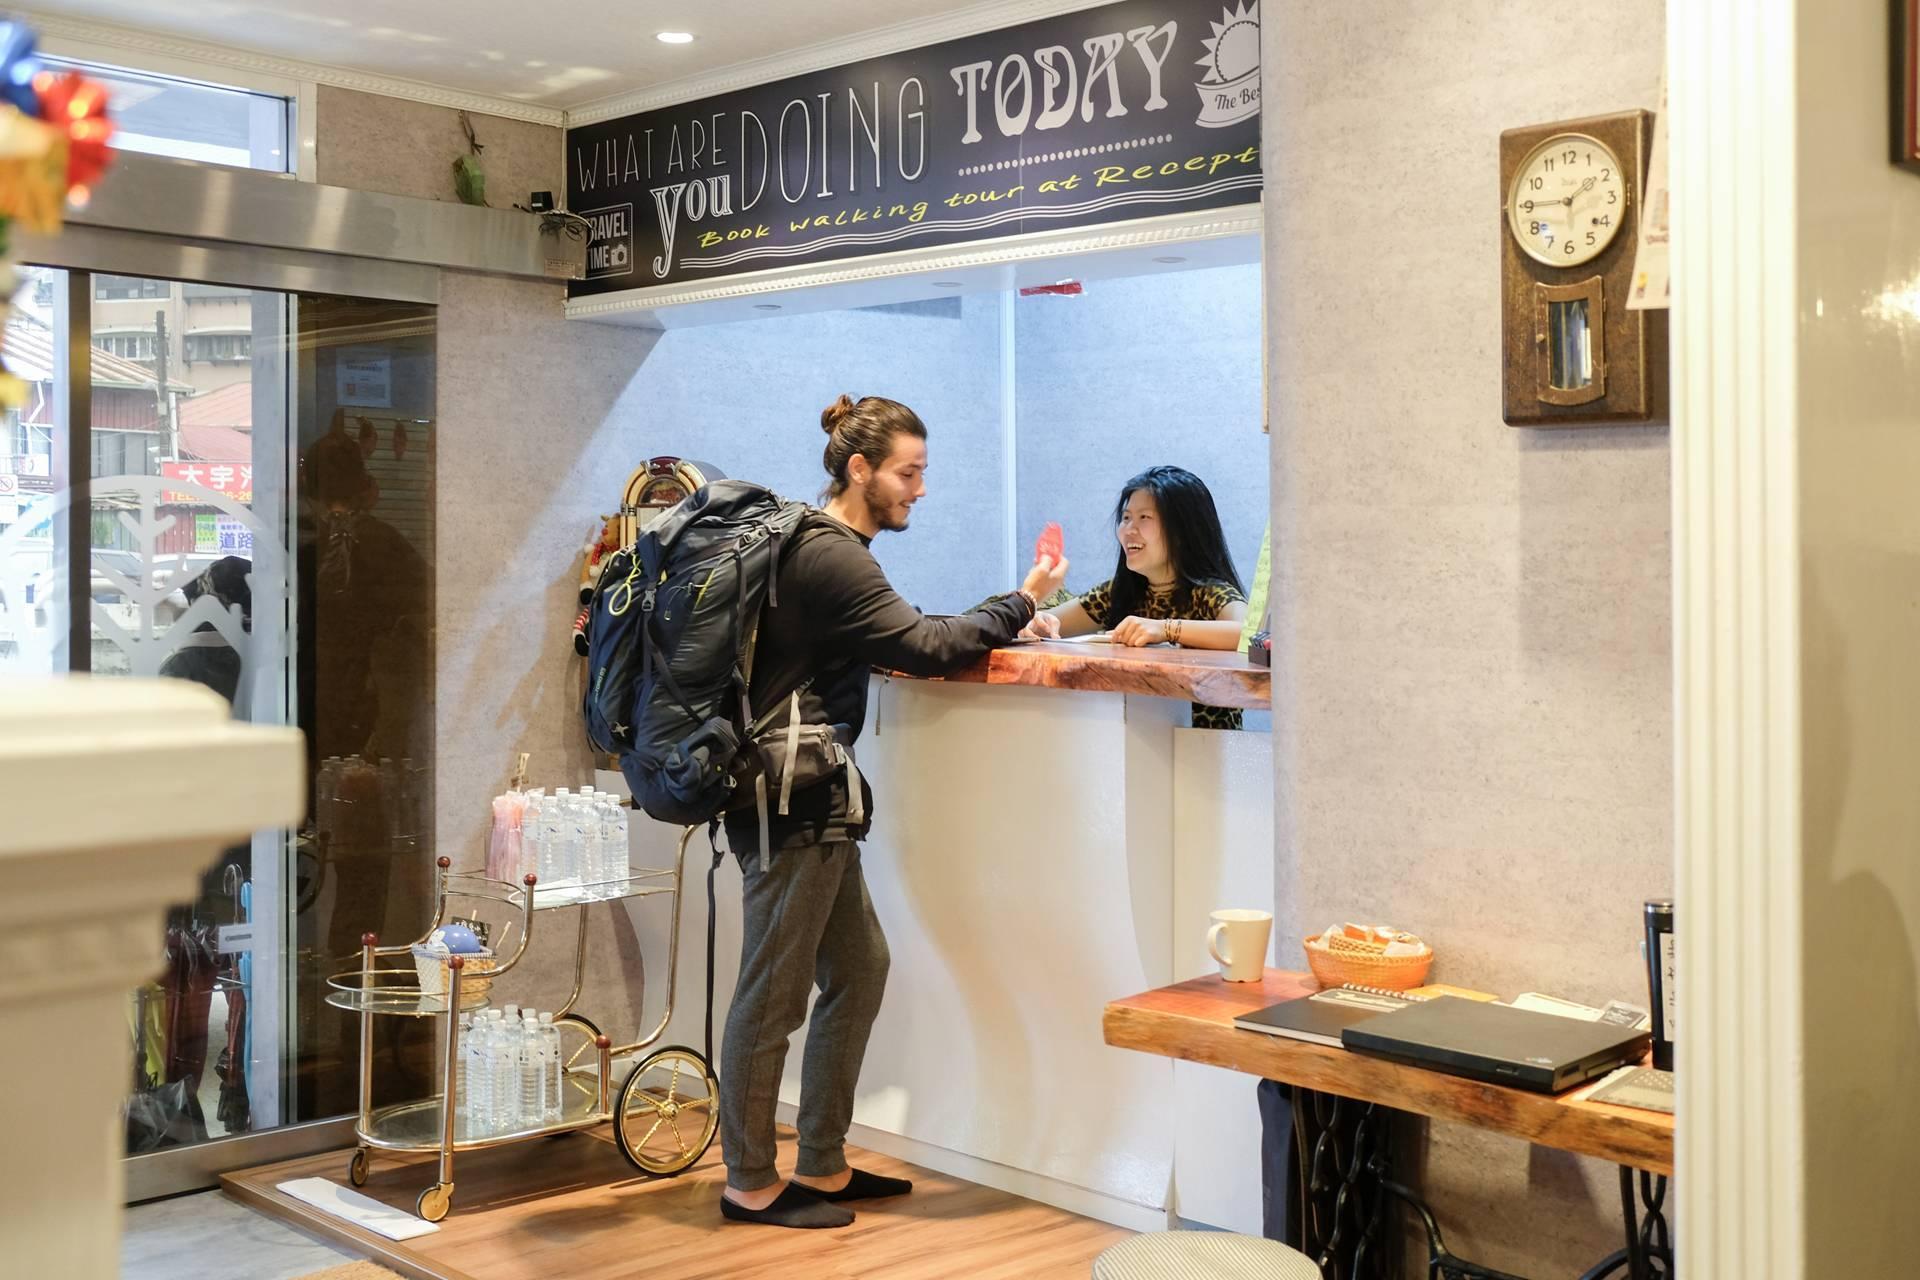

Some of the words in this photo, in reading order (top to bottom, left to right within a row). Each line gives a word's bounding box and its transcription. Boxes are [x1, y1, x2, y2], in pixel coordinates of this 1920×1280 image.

[1215, 93, 1237, 110] The
[741, 77, 924, 212] DOING
[950, 20, 1178, 145] TODAY
[577, 128, 653, 192] WHAT
[667, 112, 728, 174] ARE
[1562, 150, 1577, 165] 12
[1544, 158, 1554, 172] 11
[1586, 153, 1592, 166] 1
[1600, 168, 1610, 182] 2
[1530, 177, 1543, 191] 10
[698, 225, 769, 249] Book
[789, 201, 928, 232] walking
[944, 184, 1024, 208] tour
[1038, 175, 1081, 193] at
[1093, 147, 1259, 189] Recept
[1607, 190, 1617, 204] 3
[1524, 200, 1534, 213] 9
[587, 211, 628, 241] RAVEL
[650, 174, 733, 279] you
[1530, 221, 1540, 235] 8
[1599, 214, 1610, 228] 4
[1545, 236, 1554, 249] 7
[1585, 232, 1595, 245] 5
[1564, 240, 1575, 254] 6
[589, 245, 610, 269] IME
